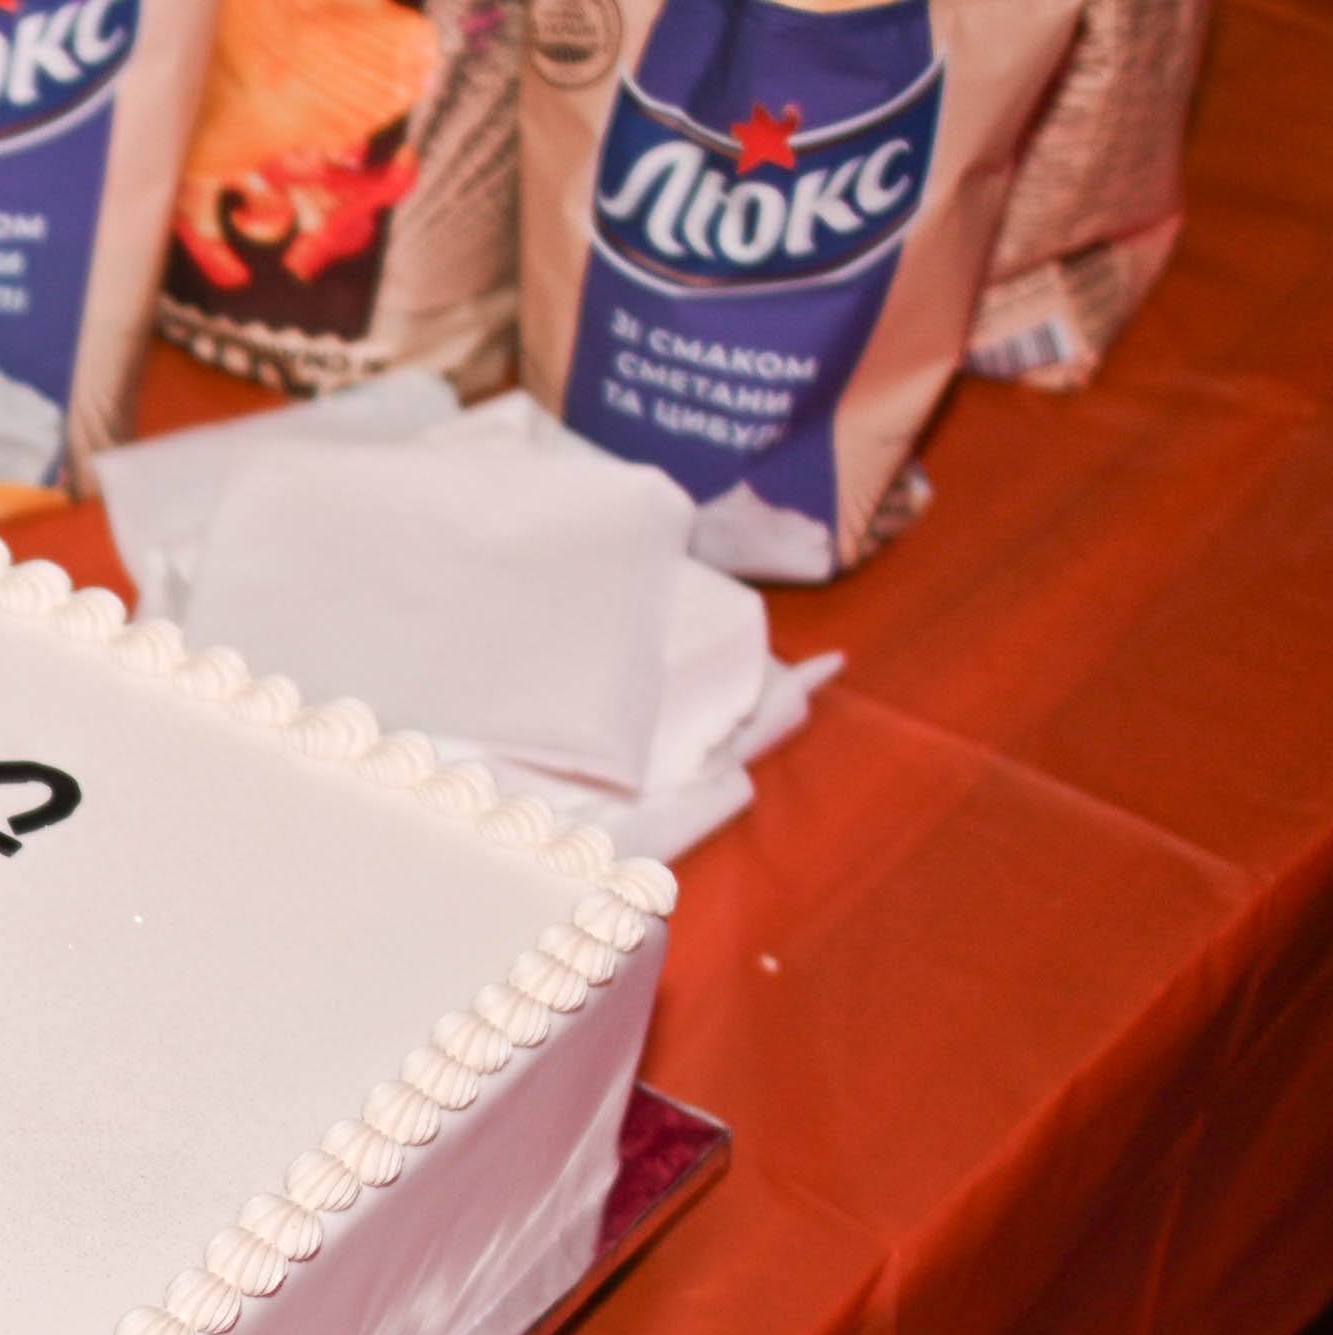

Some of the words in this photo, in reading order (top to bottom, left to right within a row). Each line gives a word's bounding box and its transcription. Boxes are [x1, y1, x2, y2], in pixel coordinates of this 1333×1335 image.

[598, 138, 910, 263] Люкс
[616, 351, 792, 415] СМЕТАНИ
[648, 328, 817, 383] СМАКОМ
[602, 376, 644, 417] ТА
